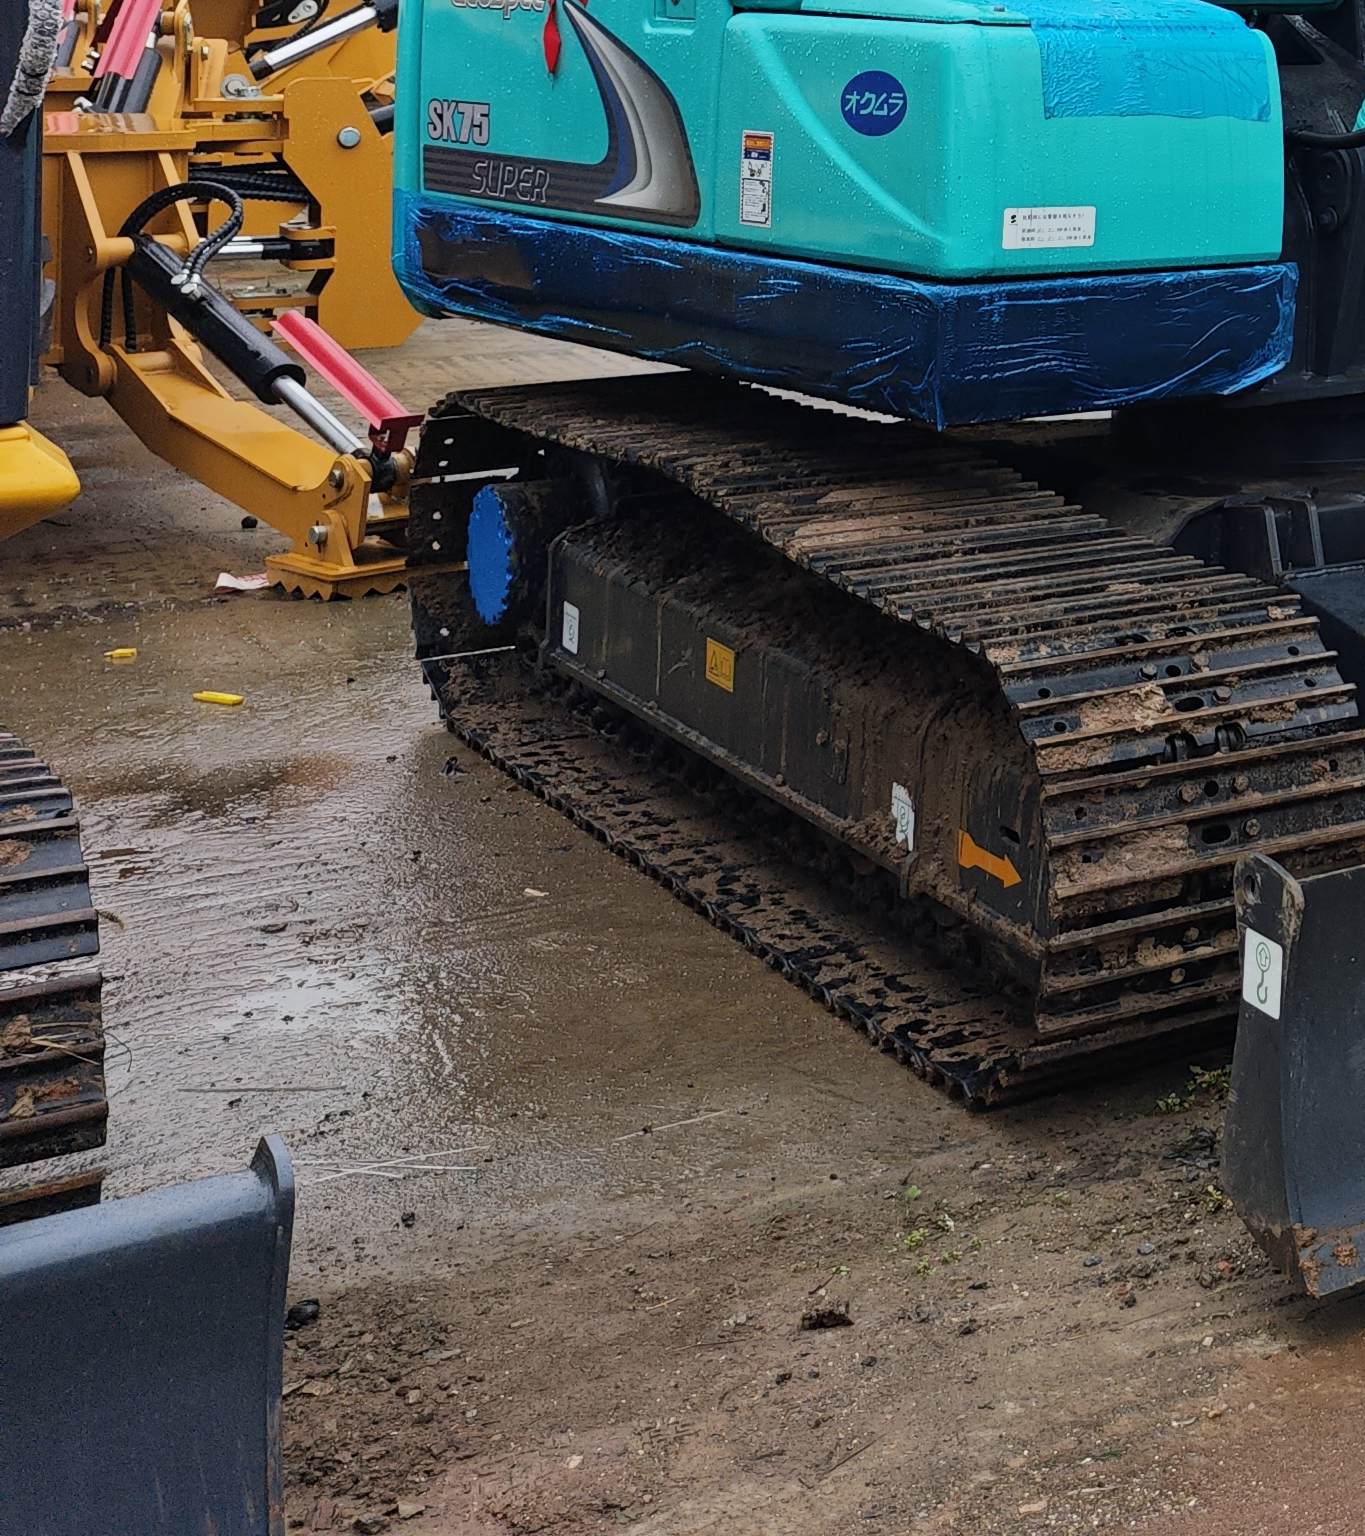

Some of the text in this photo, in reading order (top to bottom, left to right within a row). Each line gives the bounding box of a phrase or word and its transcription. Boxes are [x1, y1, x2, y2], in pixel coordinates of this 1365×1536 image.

[428, 98, 490, 146] SK75
[844, 90, 904, 116] オクムラ
[470, 160, 550, 203] SUPER
